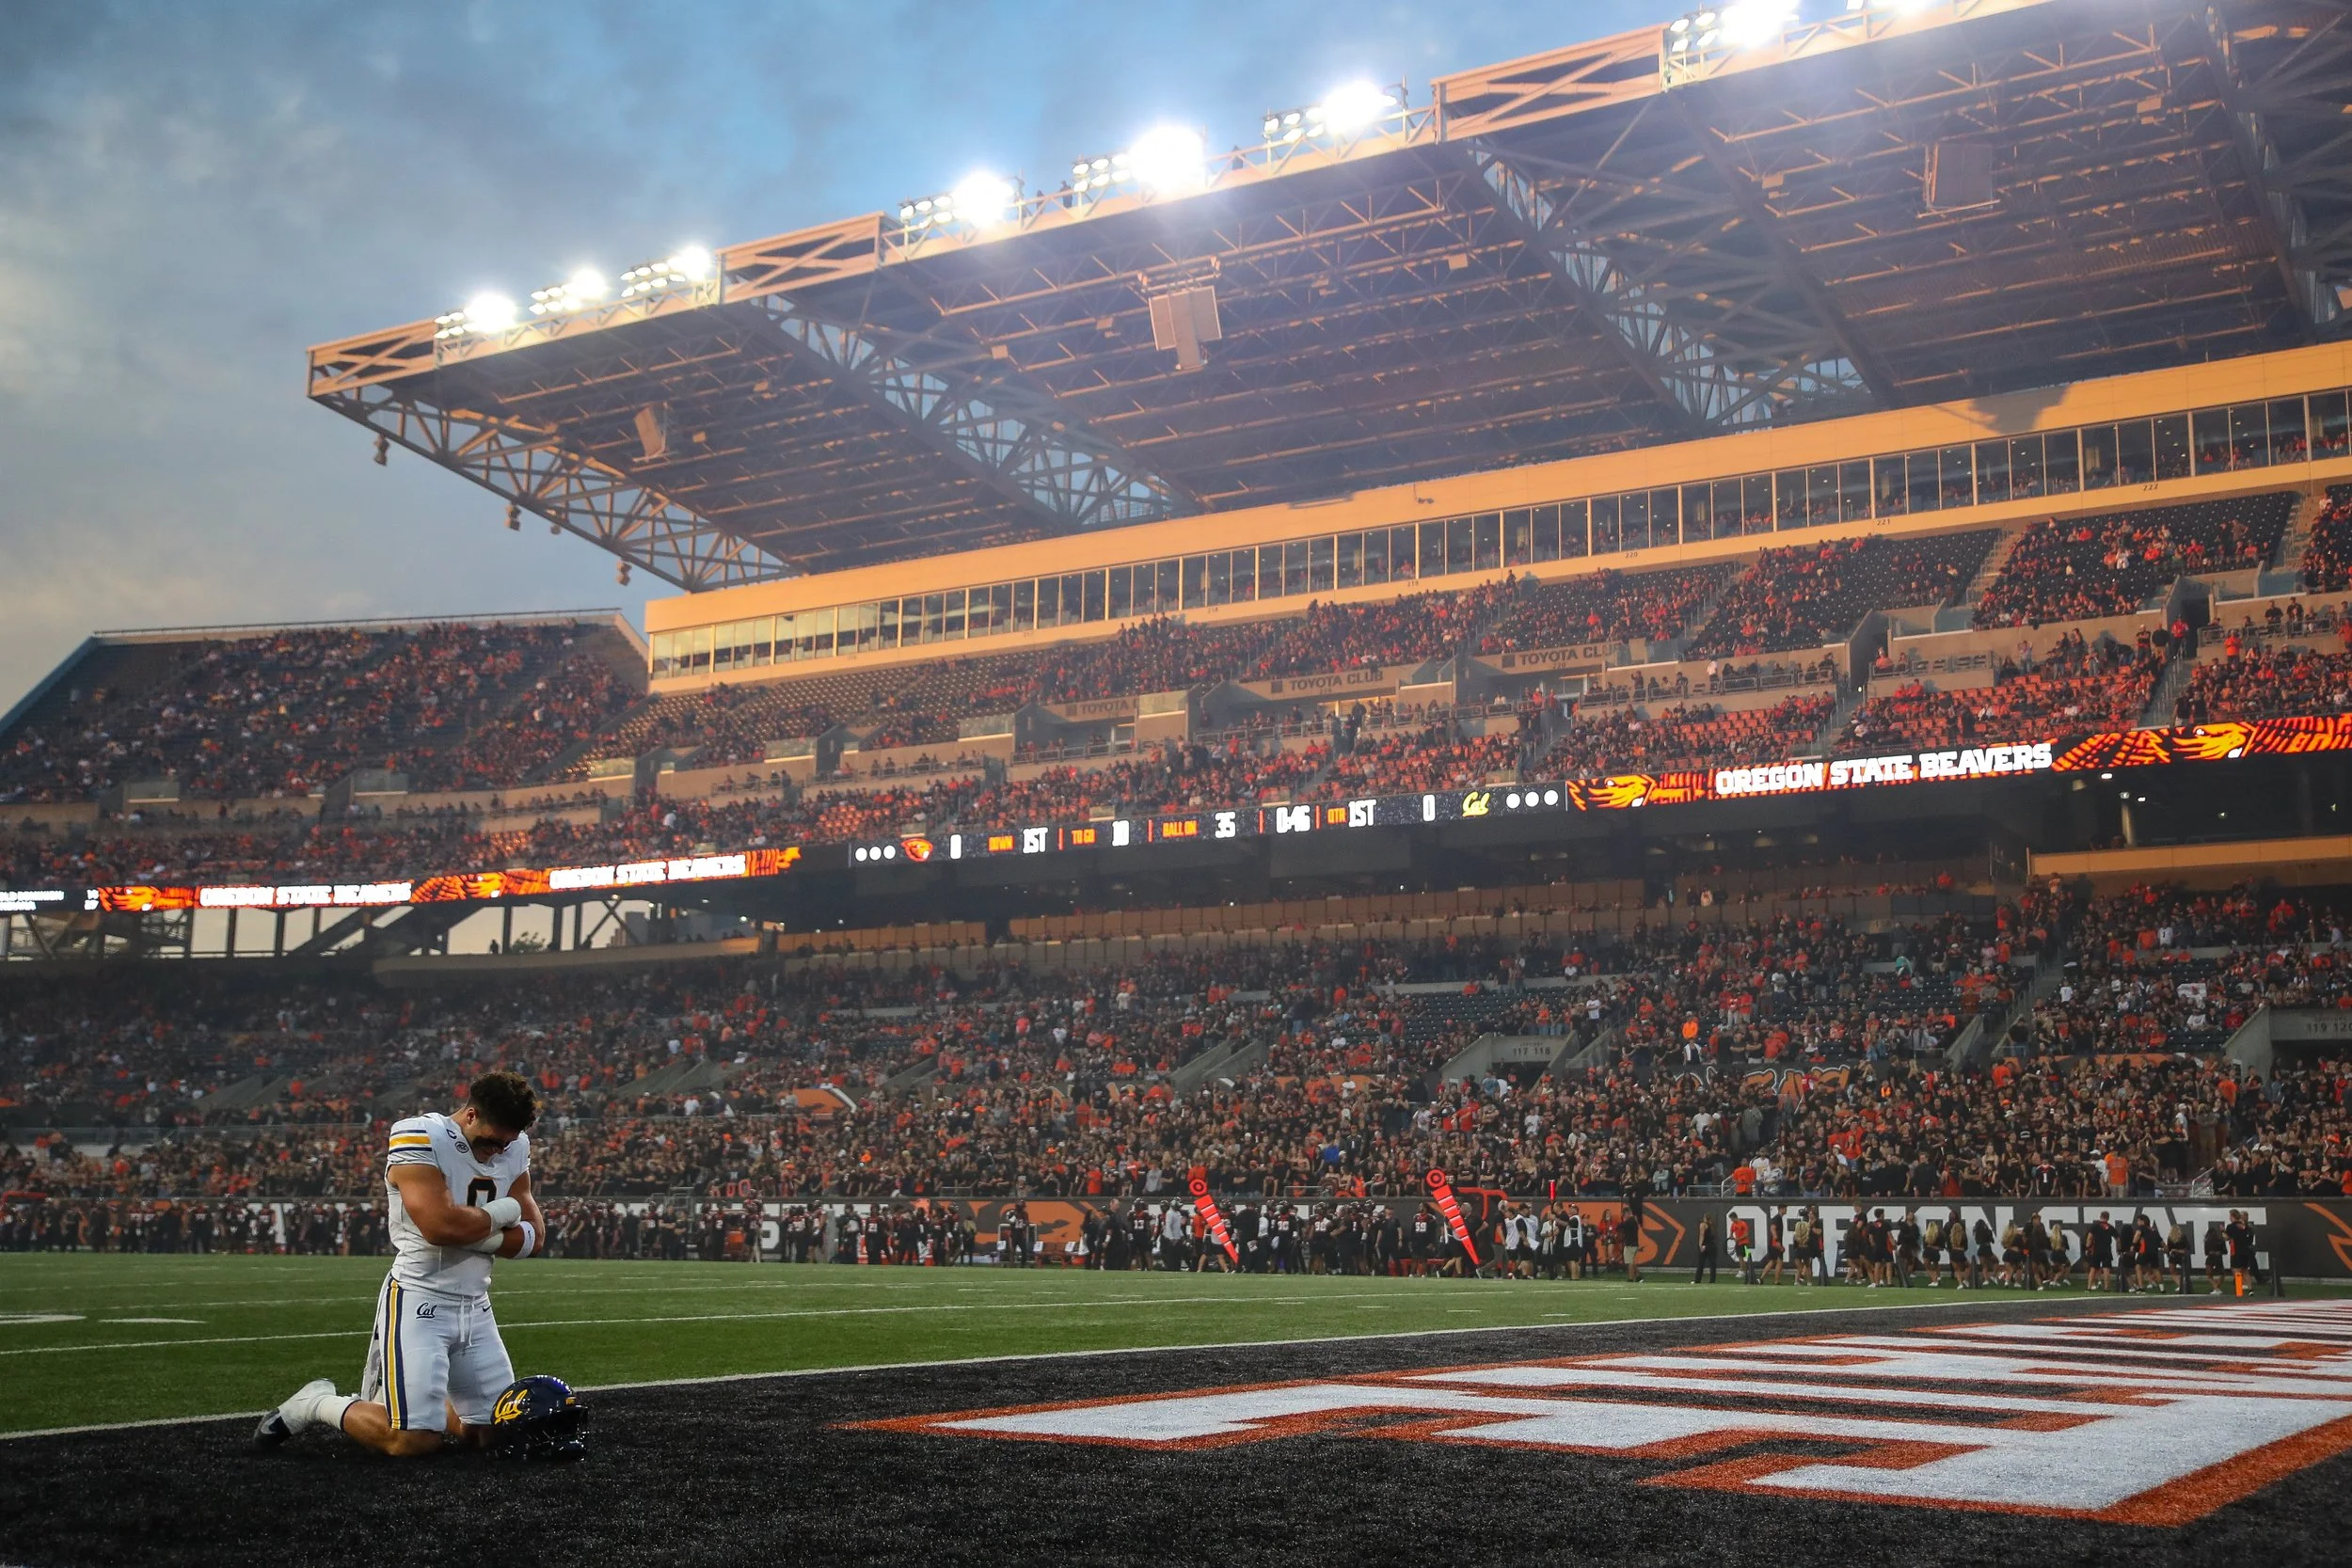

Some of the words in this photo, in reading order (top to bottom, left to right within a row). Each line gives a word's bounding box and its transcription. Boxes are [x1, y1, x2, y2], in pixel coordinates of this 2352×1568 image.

[1518, 648, 1579, 666] TOYOTA
[1583, 641, 1619, 658] CLU
[1291, 674, 1343, 691] TOYOTA
[1079, 699, 1129, 715] TOYOTA
[1715, 761, 1823, 796] OREGON
[1830, 754, 1914, 786] STATE
[1918, 742, 2053, 779] BEAVERS
[1461, 790, 1490, 817] Cal
[1327, 807, 1346, 824] QTR
[1348, 800, 1377, 828] 1ST
[1071, 830, 1082, 845] TO
[1162, 822, 1184, 838] BALL
[1184, 819, 1198, 835] ON
[1023, 827, 1048, 853] 1ST
[2307, 1022, 2328, 1033] 119
[1513, 1047, 1528, 1055] 117
[1534, 1046, 1550, 1054] 118
[415, 1302, 437, 1319] Cal
[494, 1388, 528, 1425] Cal
